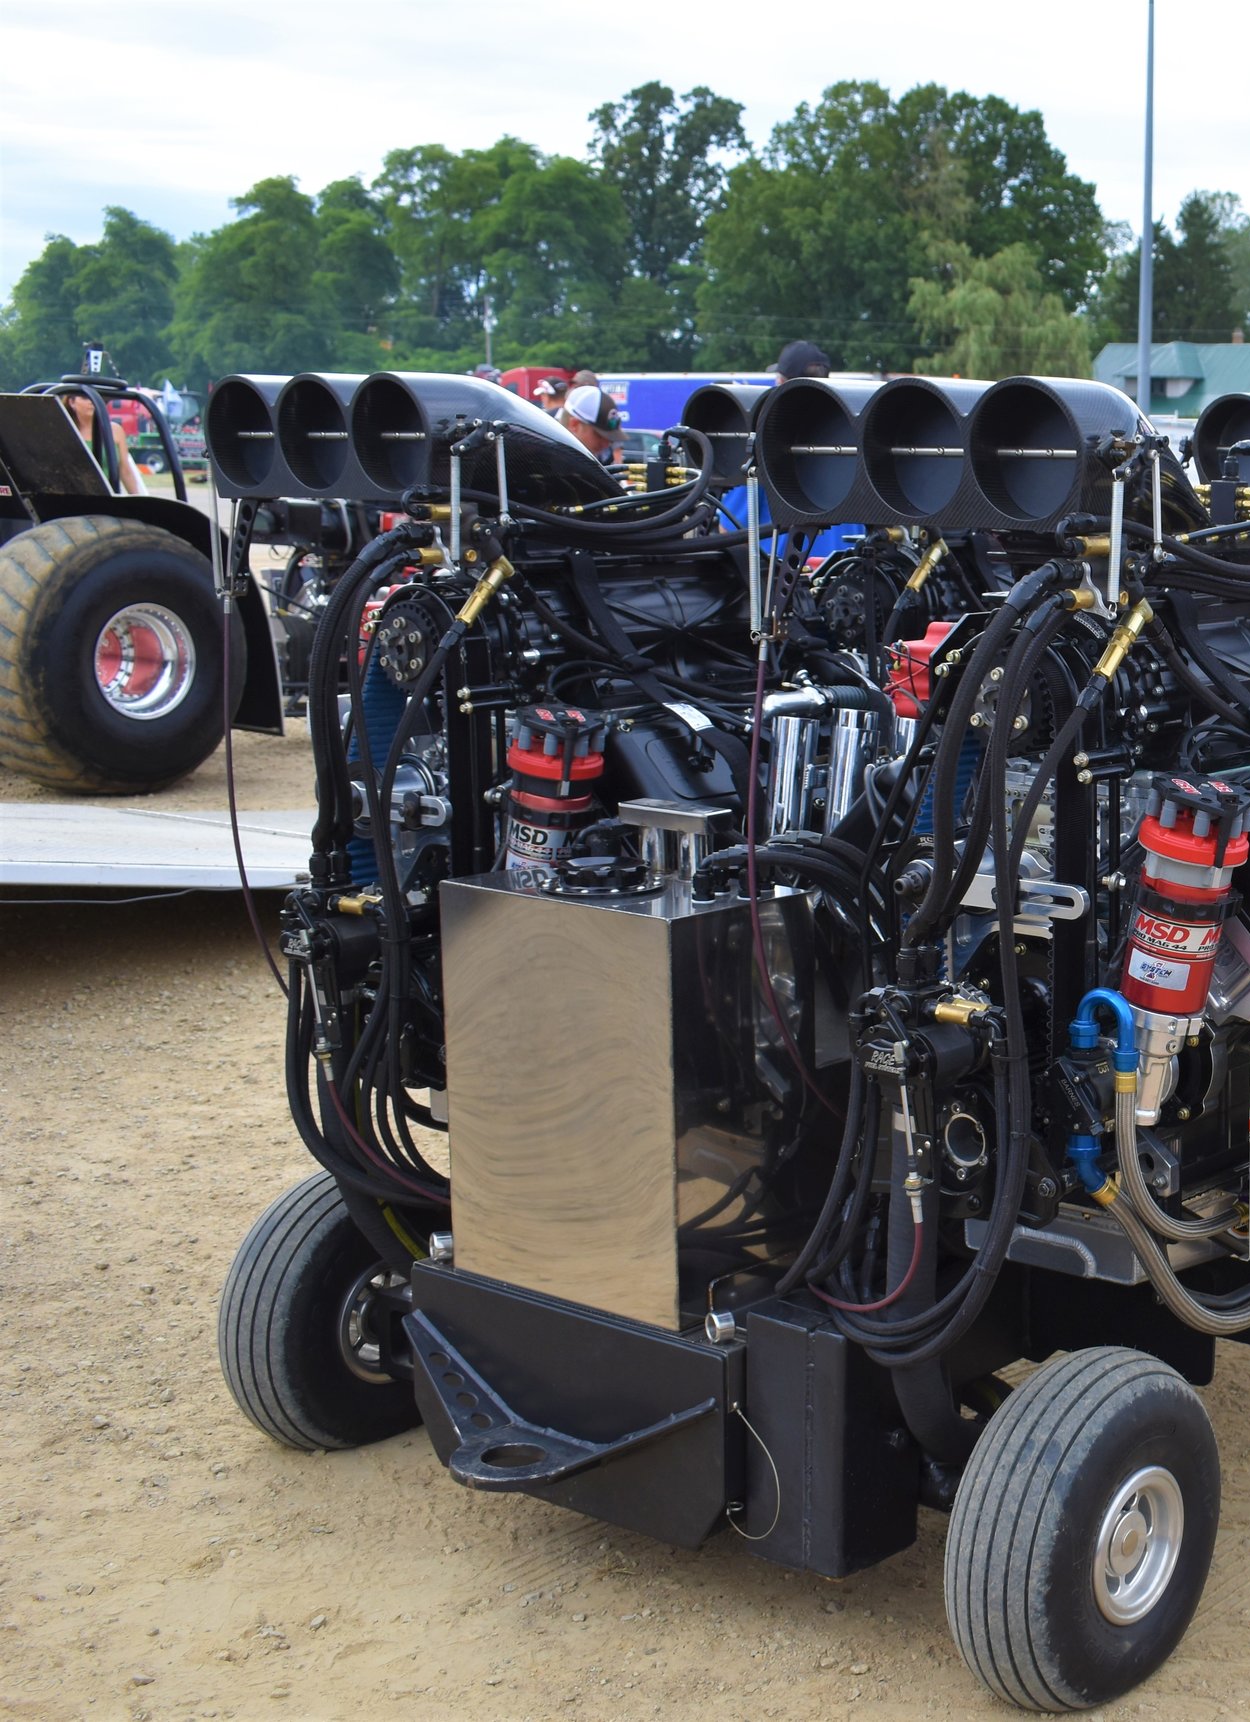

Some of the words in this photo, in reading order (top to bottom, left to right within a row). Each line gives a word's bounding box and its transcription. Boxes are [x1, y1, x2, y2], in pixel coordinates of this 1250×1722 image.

[509, 820, 548, 846] MSD
[1135, 914, 1190, 944] MSD
[1061, 1078, 1081, 1108] BARNES
